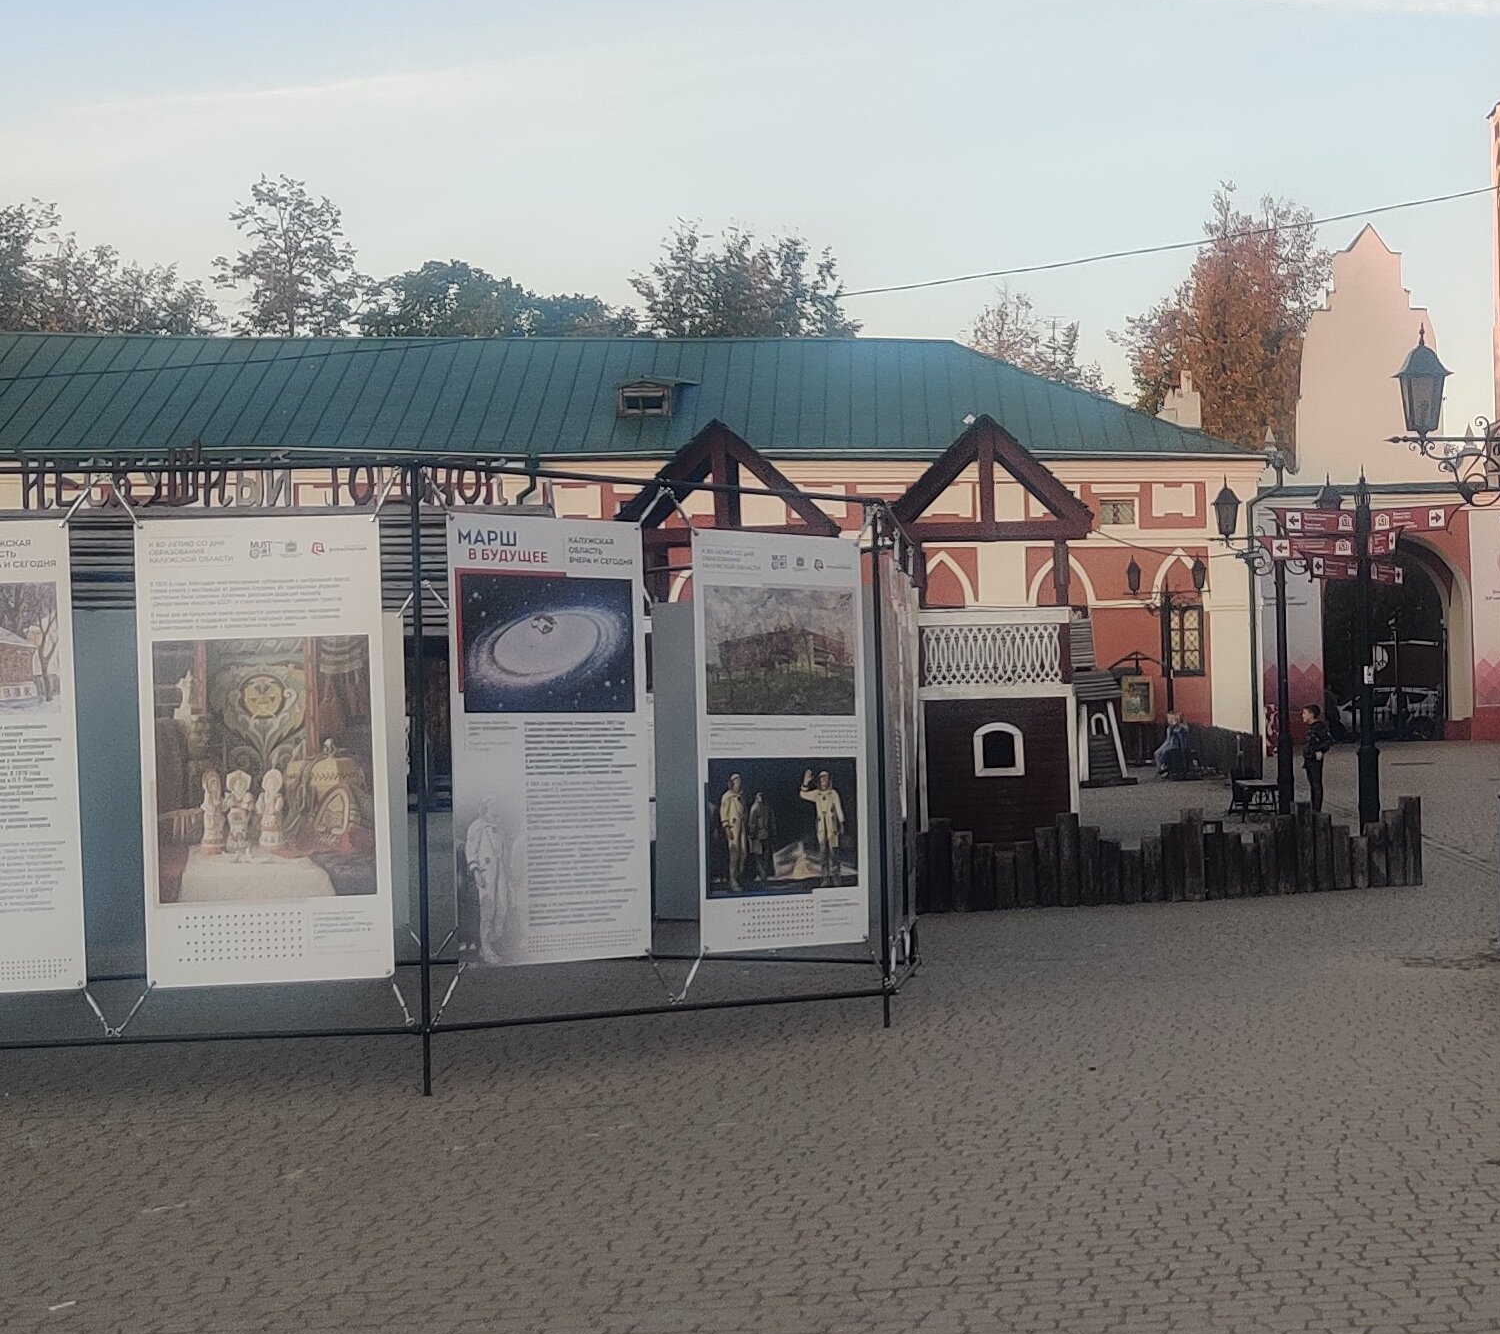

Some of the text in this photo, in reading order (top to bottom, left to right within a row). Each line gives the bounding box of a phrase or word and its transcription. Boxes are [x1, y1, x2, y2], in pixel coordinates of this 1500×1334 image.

[457, 528, 517, 547] МАРШ
[469, 548, 549, 563] В БУДУЩЕЕ
[13, 559, 57, 568] СЕГОДНЯ
